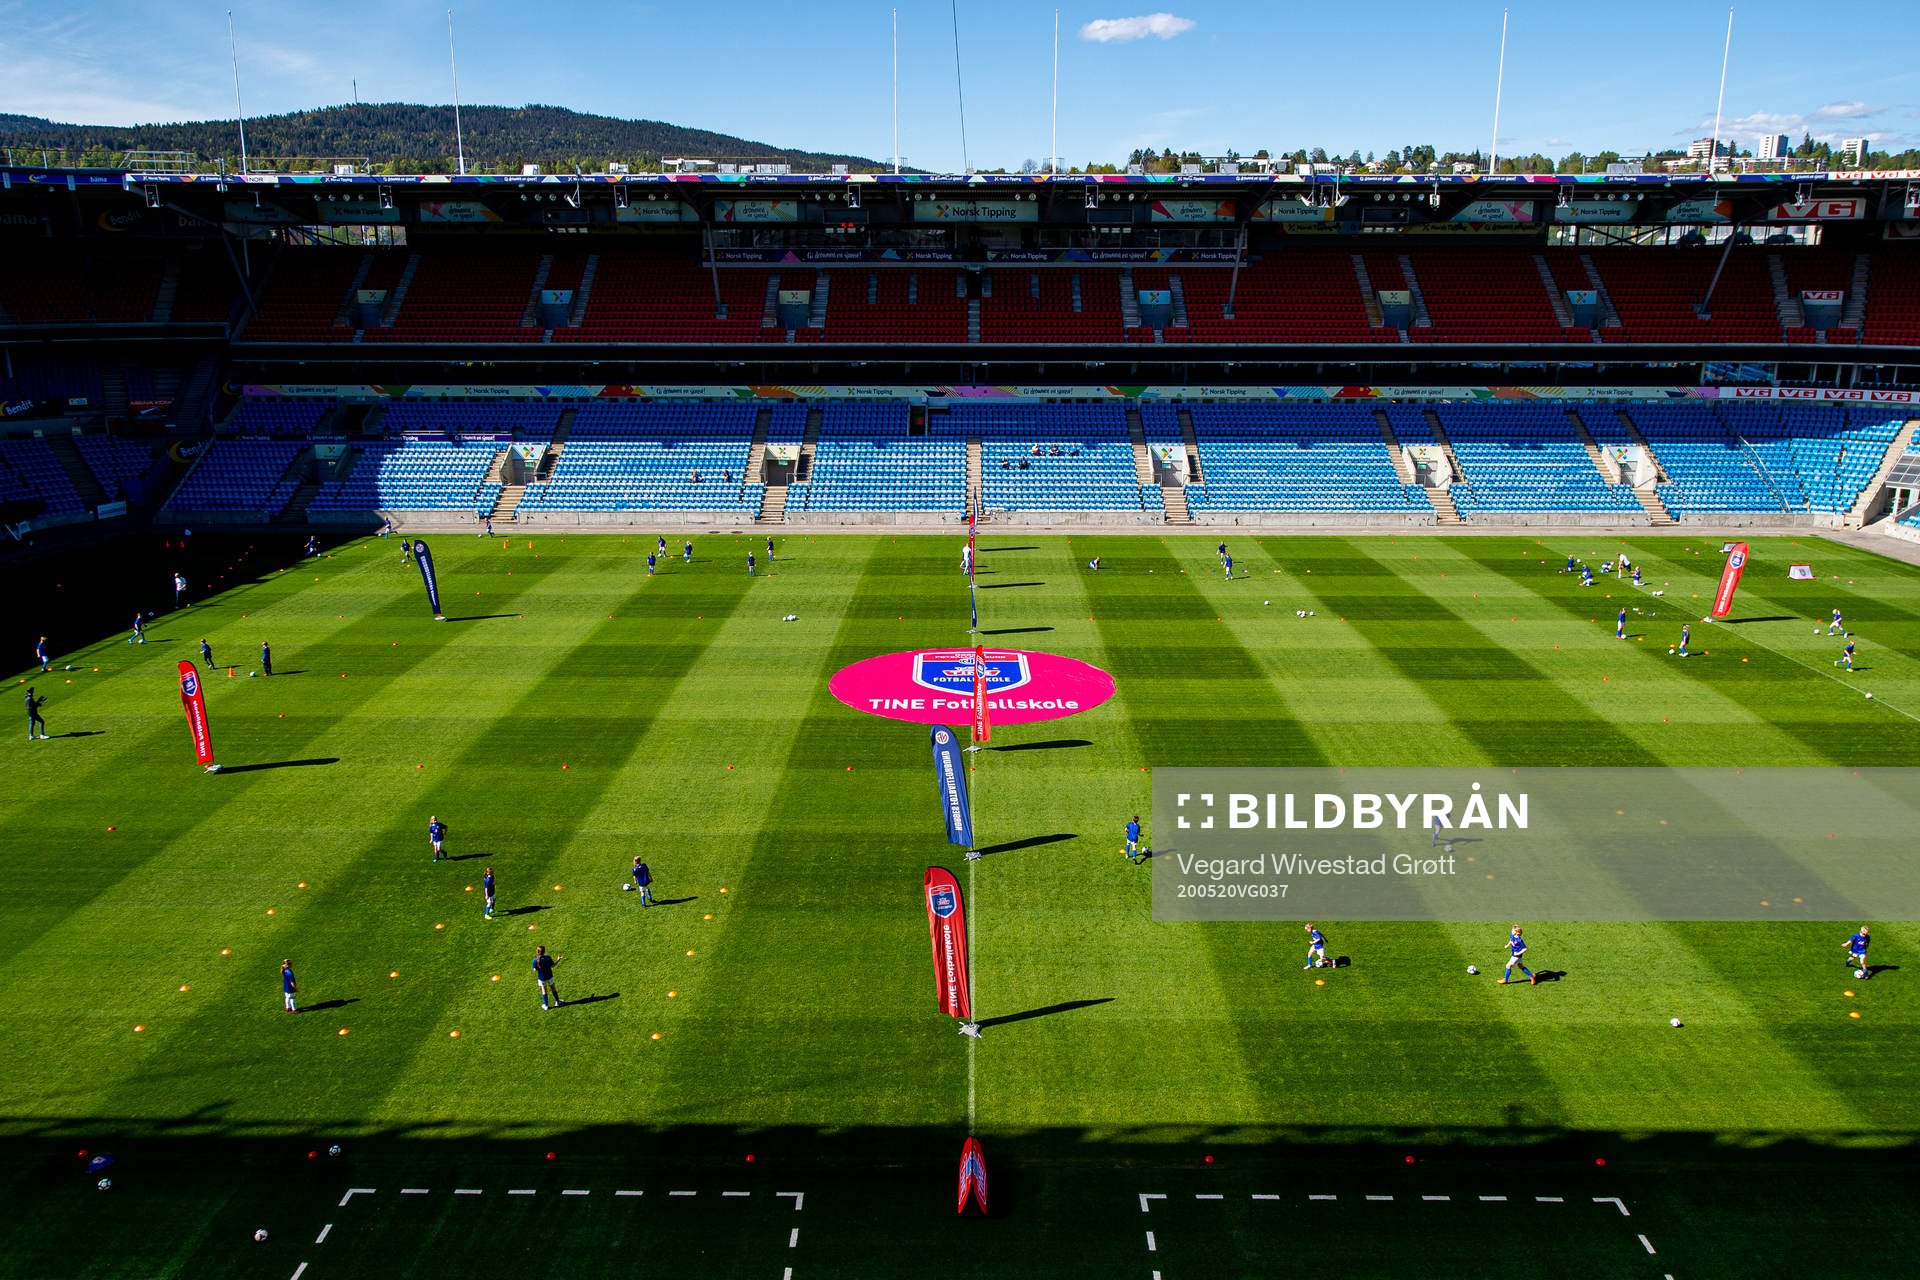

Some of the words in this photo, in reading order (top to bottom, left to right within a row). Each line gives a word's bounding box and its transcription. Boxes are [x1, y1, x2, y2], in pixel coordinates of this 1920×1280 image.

[952, 208, 980, 217] Norsk
[981, 208, 1016, 218] Tipping
[1599, 208, 1621, 216] Tipping
[1776, 200, 1857, 218] VG
[1737, 388, 1771, 397] VG
[1779, 388, 1817, 398] VG
[1824, 390, 1863, 400] VG
[1871, 391, 1911, 401] VG
[869, 698, 925, 710] TINE
